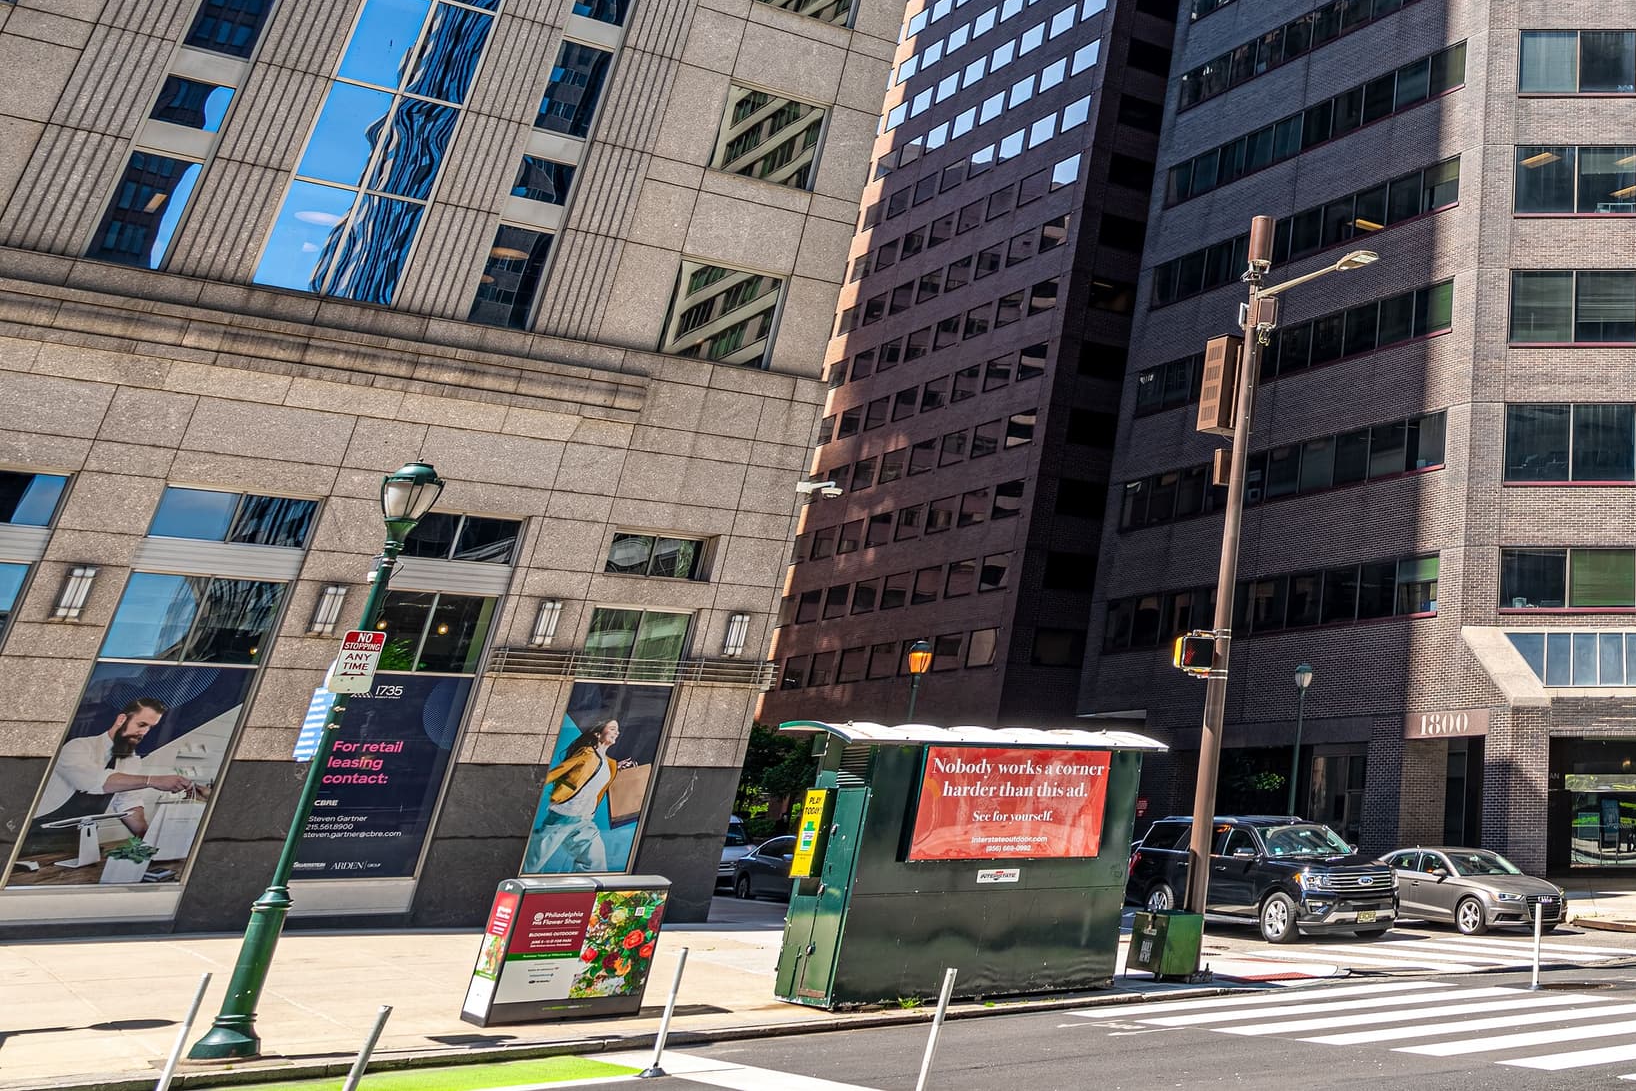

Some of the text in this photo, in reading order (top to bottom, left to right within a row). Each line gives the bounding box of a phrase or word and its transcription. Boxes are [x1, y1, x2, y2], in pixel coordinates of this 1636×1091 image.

[358, 632, 373, 642] NO
[344, 642, 380, 650] STOPPING
[345, 653, 372, 661] ANY
[344, 662, 370, 670] TIME
[376, 686, 404, 695] 1735
[1420, 712, 1468, 735] 1800
[332, 741, 404, 752] For retail
[327, 756, 383, 771] leasing
[932, 758, 1104, 778] Nobody works a corner
[322, 774, 388, 784] contact:
[943, 781, 1088, 797] harder than this ad.
[972, 811, 1053, 824] See for yourself.
